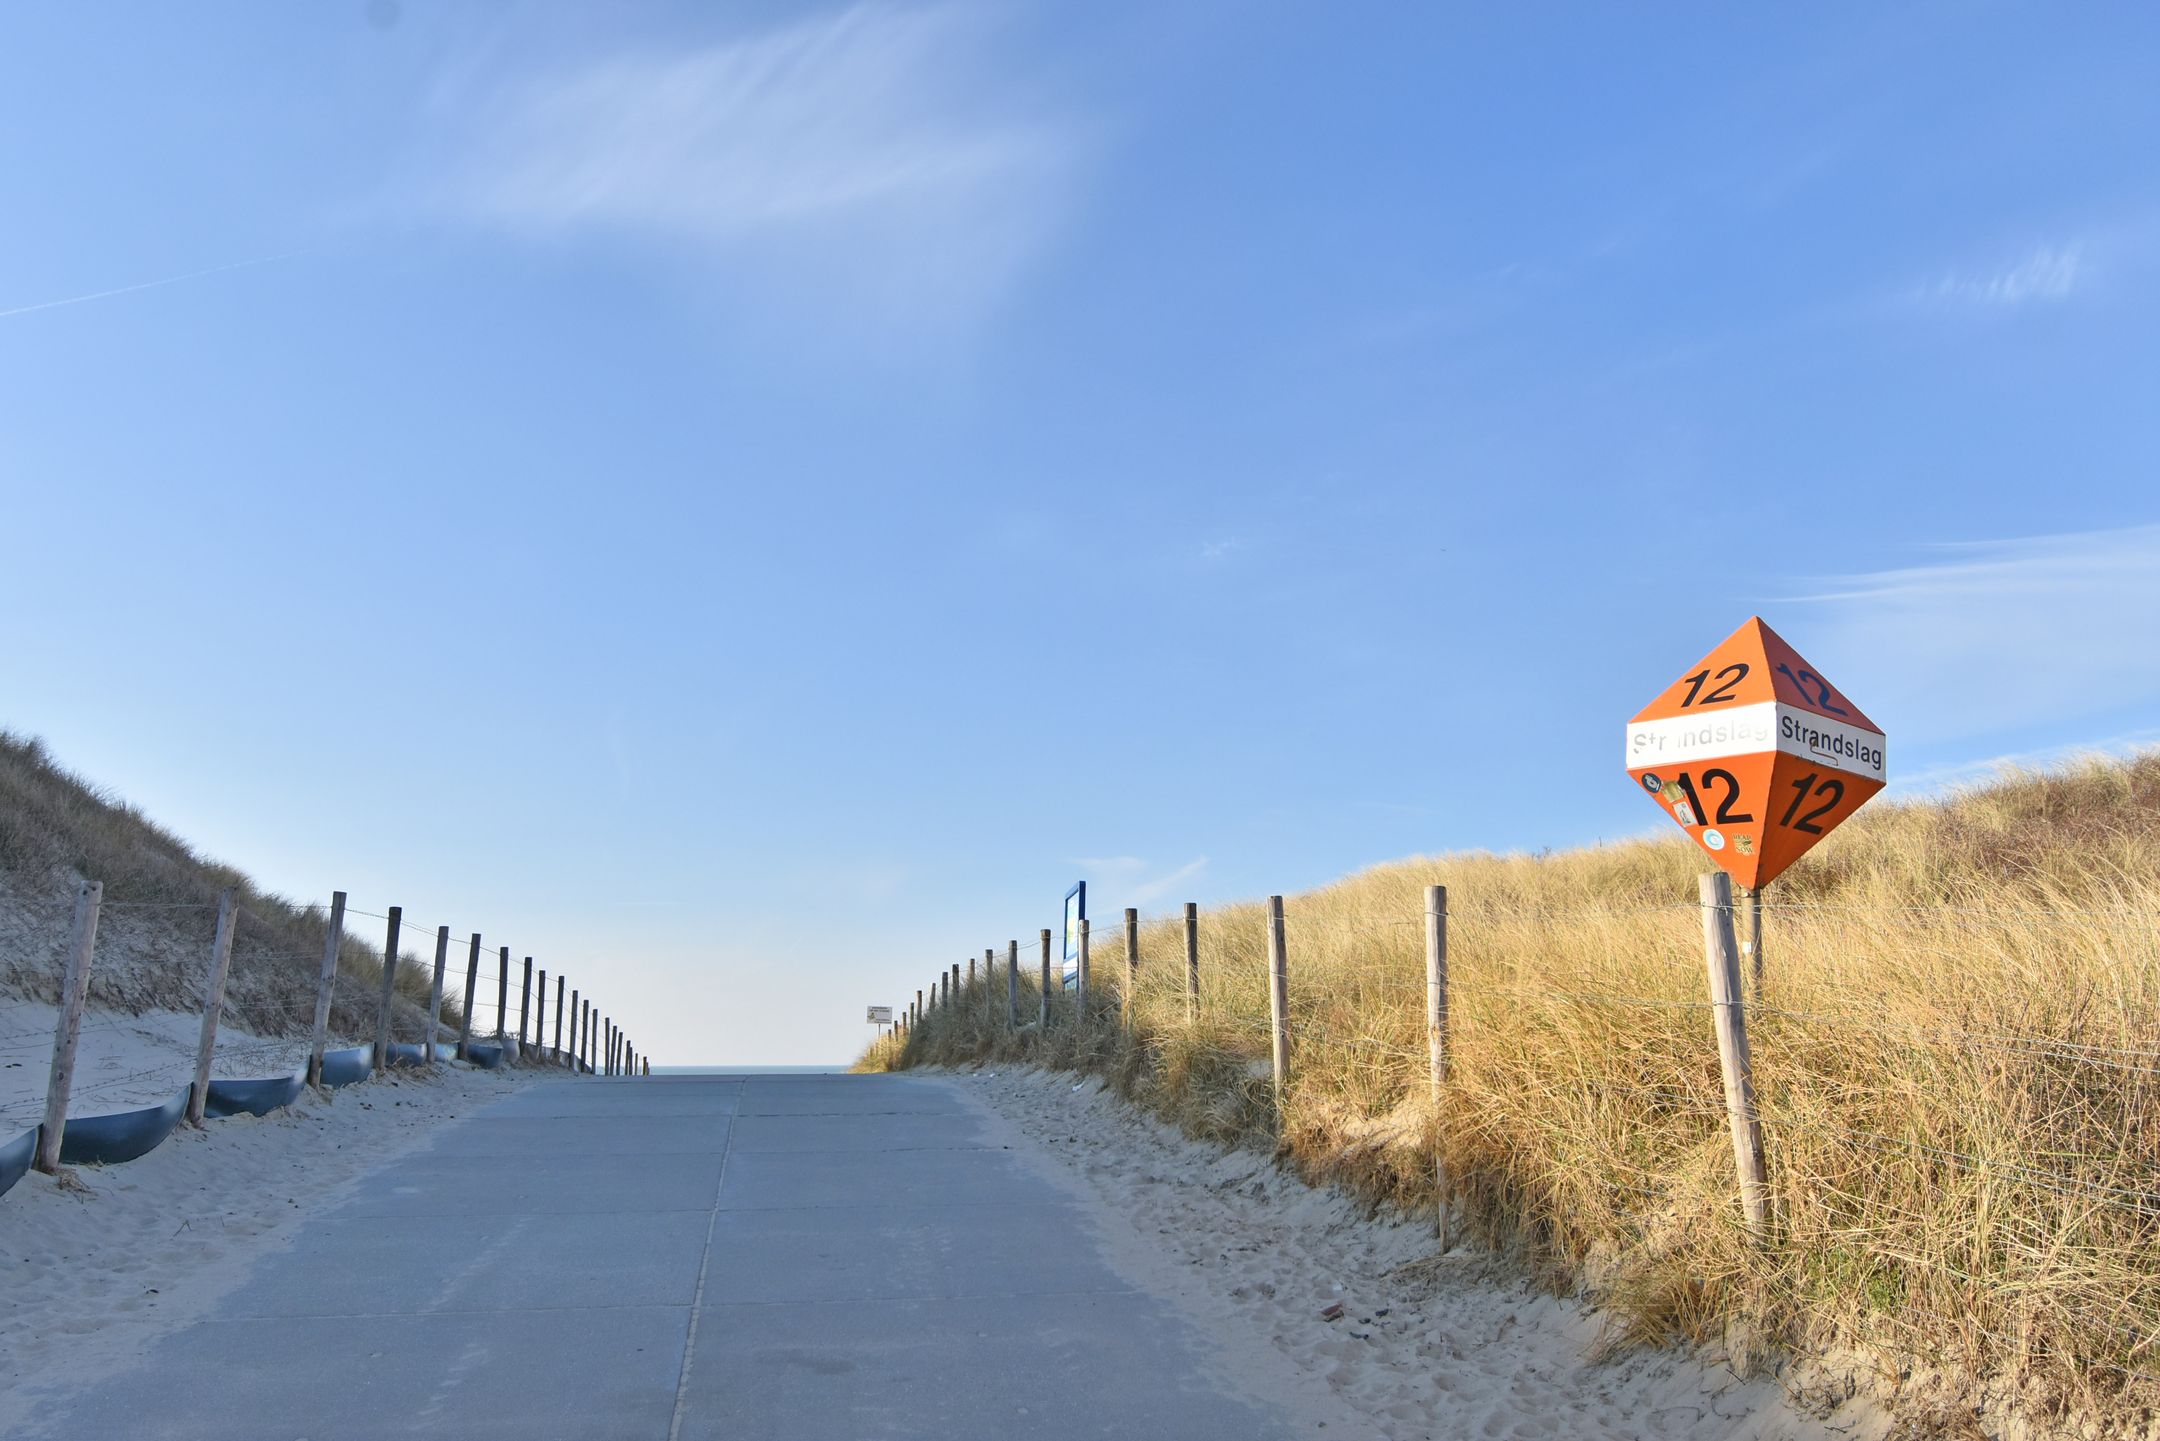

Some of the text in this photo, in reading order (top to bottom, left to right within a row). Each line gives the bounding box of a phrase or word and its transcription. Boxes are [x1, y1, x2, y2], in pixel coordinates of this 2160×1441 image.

[1681, 663, 1749, 707] 12
[1775, 662, 1848, 717] 12
[1633, 719, 1768, 754] Strndslag
[1781, 715, 1882, 771] Strandslag
[1678, 768, 1754, 826] 12
[1780, 772, 1845, 836] 12
